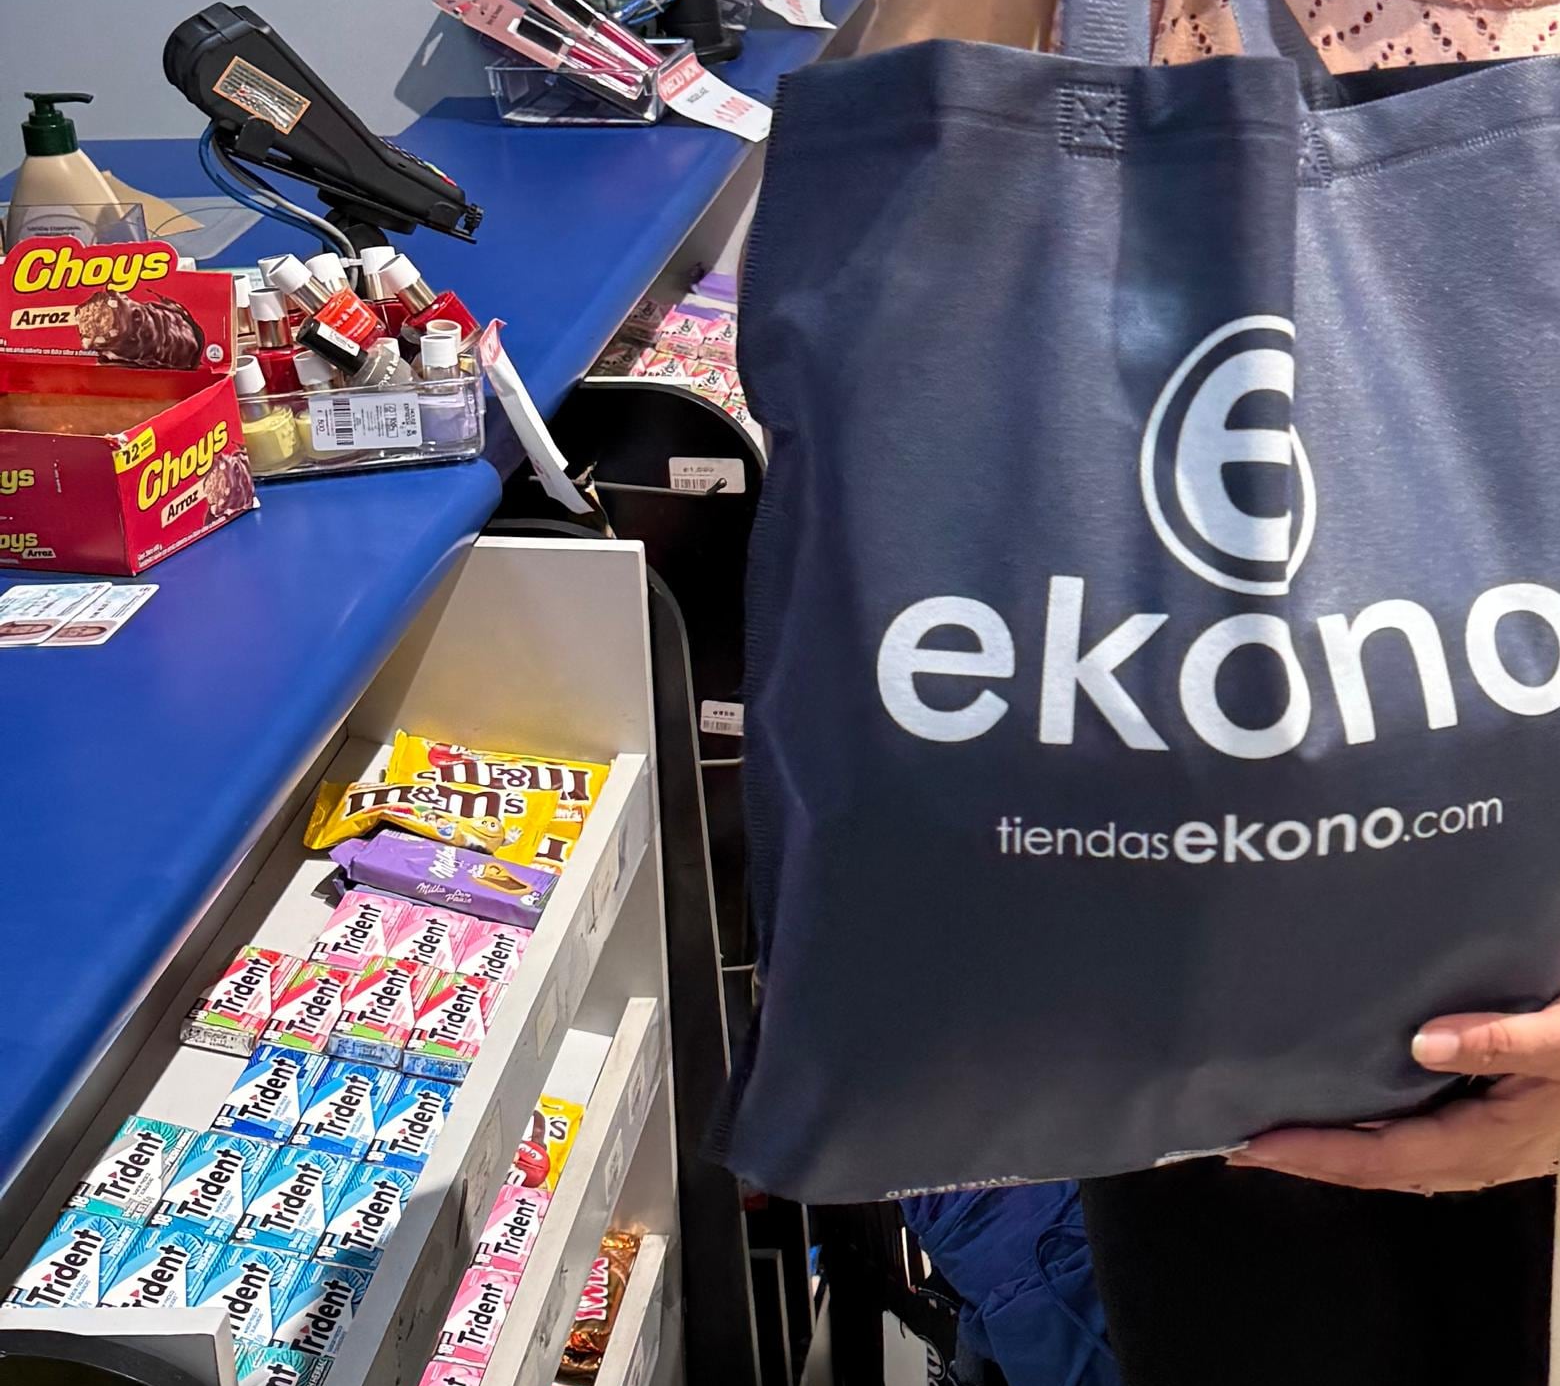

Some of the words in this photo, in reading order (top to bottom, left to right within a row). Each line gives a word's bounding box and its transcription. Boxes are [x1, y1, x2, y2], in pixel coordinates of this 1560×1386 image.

[13, 246, 171, 293] Choys
[16, 311, 70, 326] Arroz
[137, 421, 229, 512] Choys
[166, 489, 199, 522] Arroz
[995, 796, 1504, 864] tiendasekono.com
[416, 882, 447, 896] Milka
[332, 903, 383, 955] Trident
[213, 957, 272, 1014] Trident
[286, 977, 342, 1036] Trident
[357, 967, 412, 1026] Trident
[429, 983, 480, 1041] Trident
[237, 1058, 297, 1121] Trident
[314, 1074, 372, 1138] Trident
[389, 1090, 443, 1154] Trident
[94, 1130, 163, 1203] Trident
[177, 1148, 243, 1220] Trident
[260, 1162, 324, 1231] Trident
[340, 1179, 400, 1251] Trident
[494, 1196, 538, 1257] Trident
[26, 1227, 103, 1308] Trident
[289, 1280, 355, 1357] Trident
[458, 1281, 504, 1346] Trident
